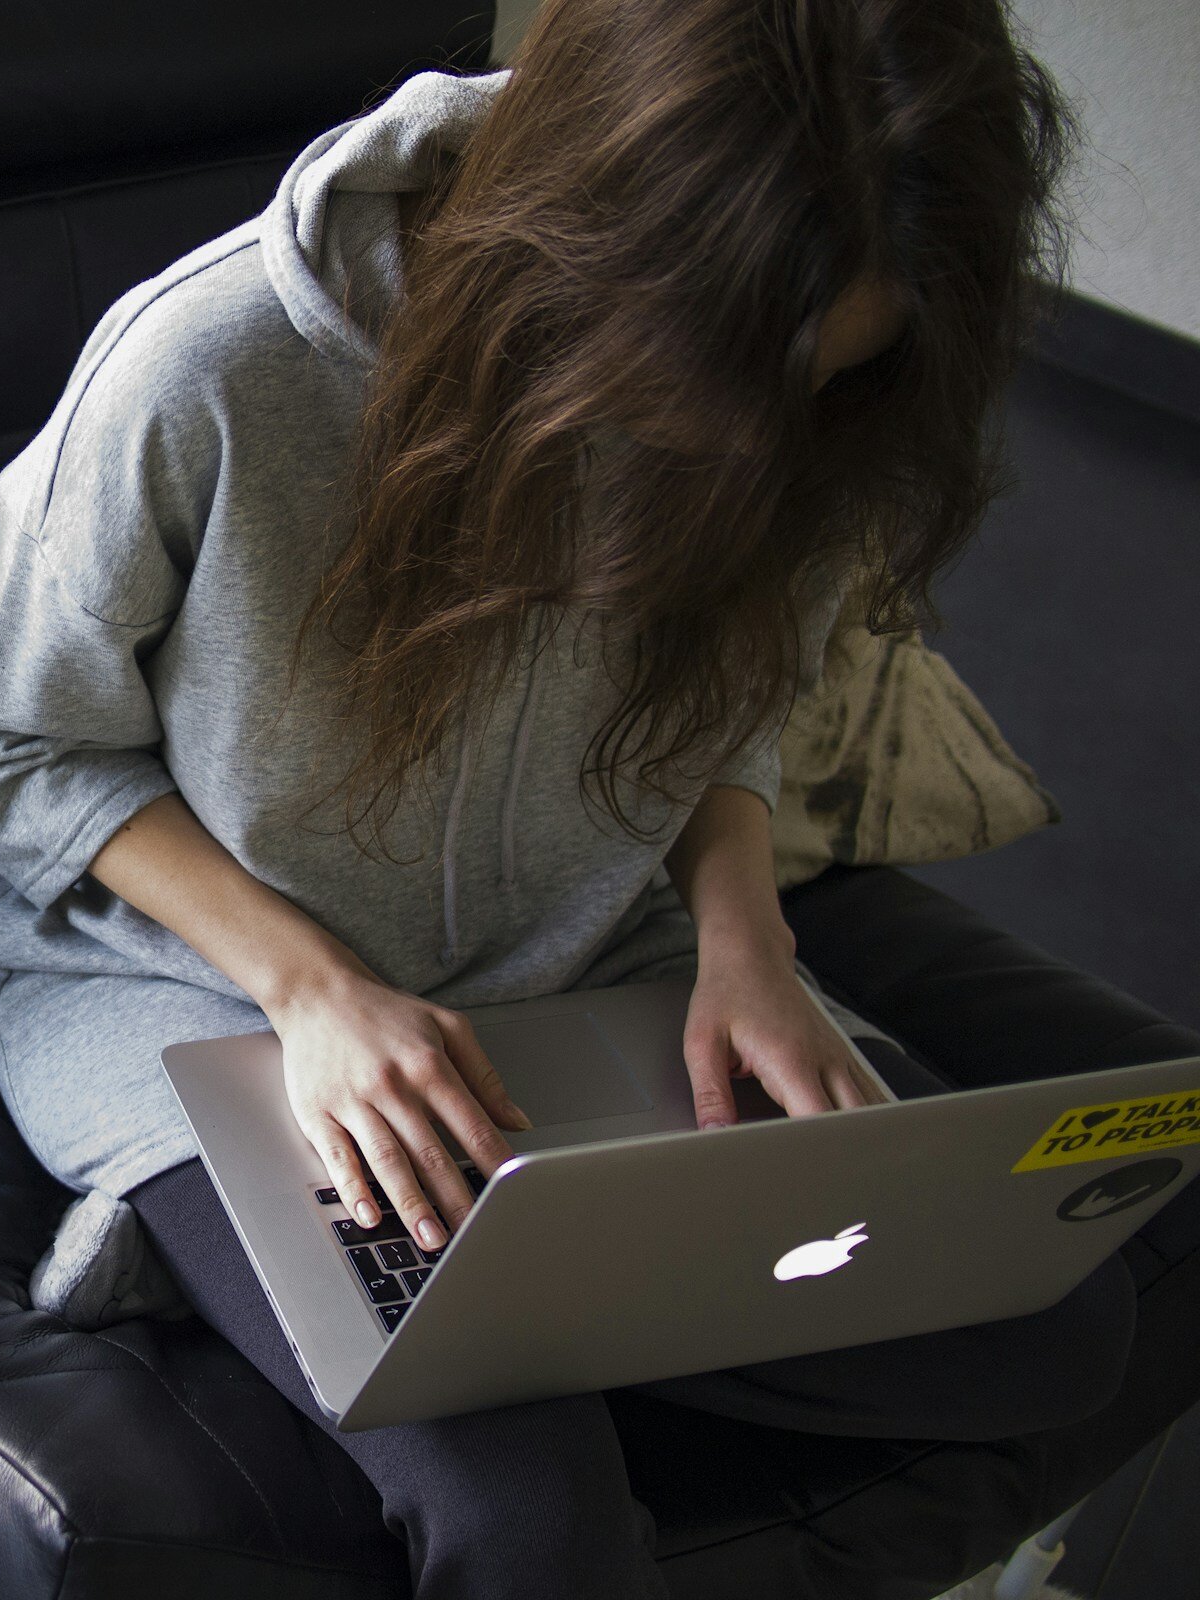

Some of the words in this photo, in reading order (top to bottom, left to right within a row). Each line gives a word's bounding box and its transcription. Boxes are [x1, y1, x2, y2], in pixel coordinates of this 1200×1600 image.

[1057, 1116, 1077, 1132] I
[1122, 1097, 1200, 1123] TALK
[1041, 1132, 1093, 1156] TO
